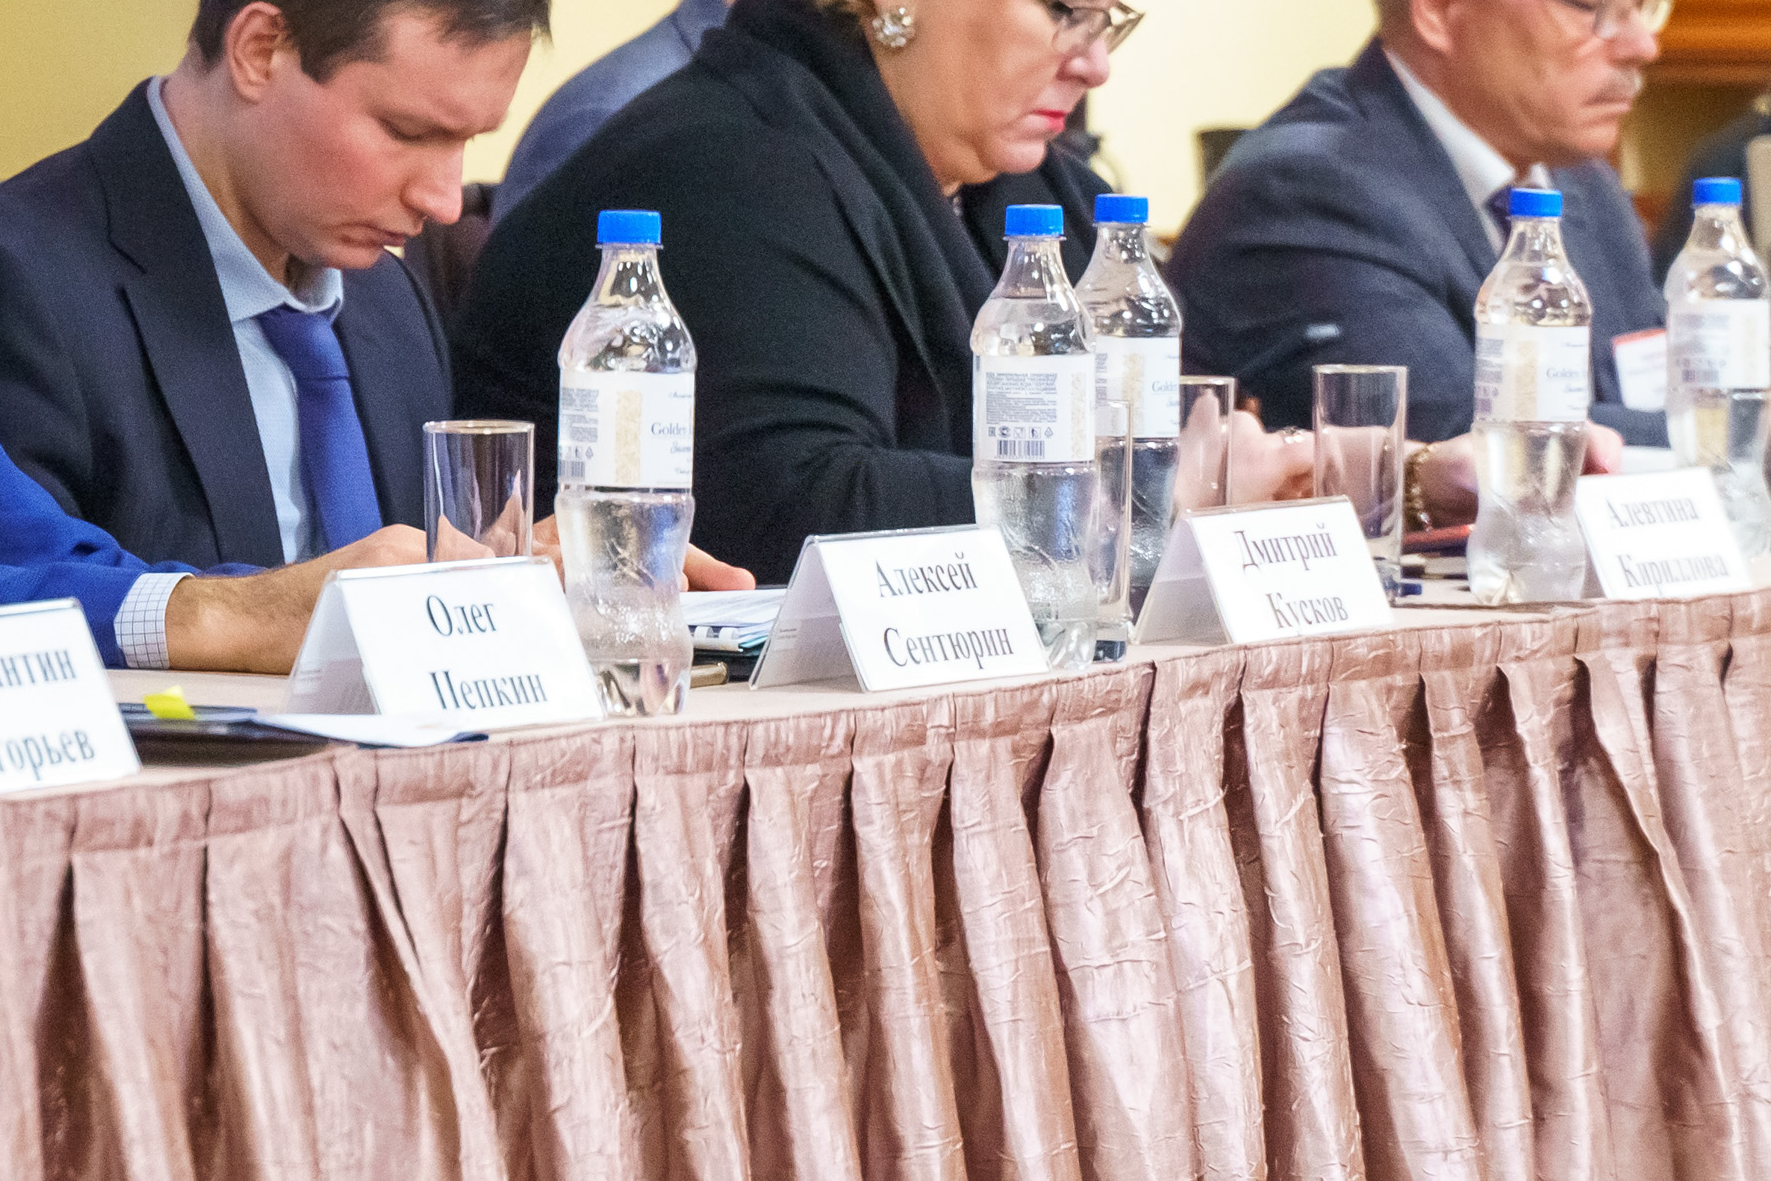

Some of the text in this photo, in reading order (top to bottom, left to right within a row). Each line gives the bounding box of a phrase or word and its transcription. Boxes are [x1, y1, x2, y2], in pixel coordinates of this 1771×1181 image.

[1605, 497, 1700, 528] Алевтина
[1233, 522, 1338, 573] Дмитрий
[875, 551, 979, 598] Алексей
[1616, 554, 1730, 596] Кириллова
[425, 595, 497, 637] Олег
[1265, 592, 1349, 634] Кусков
[883, 627, 1015, 669] Сентюрин
